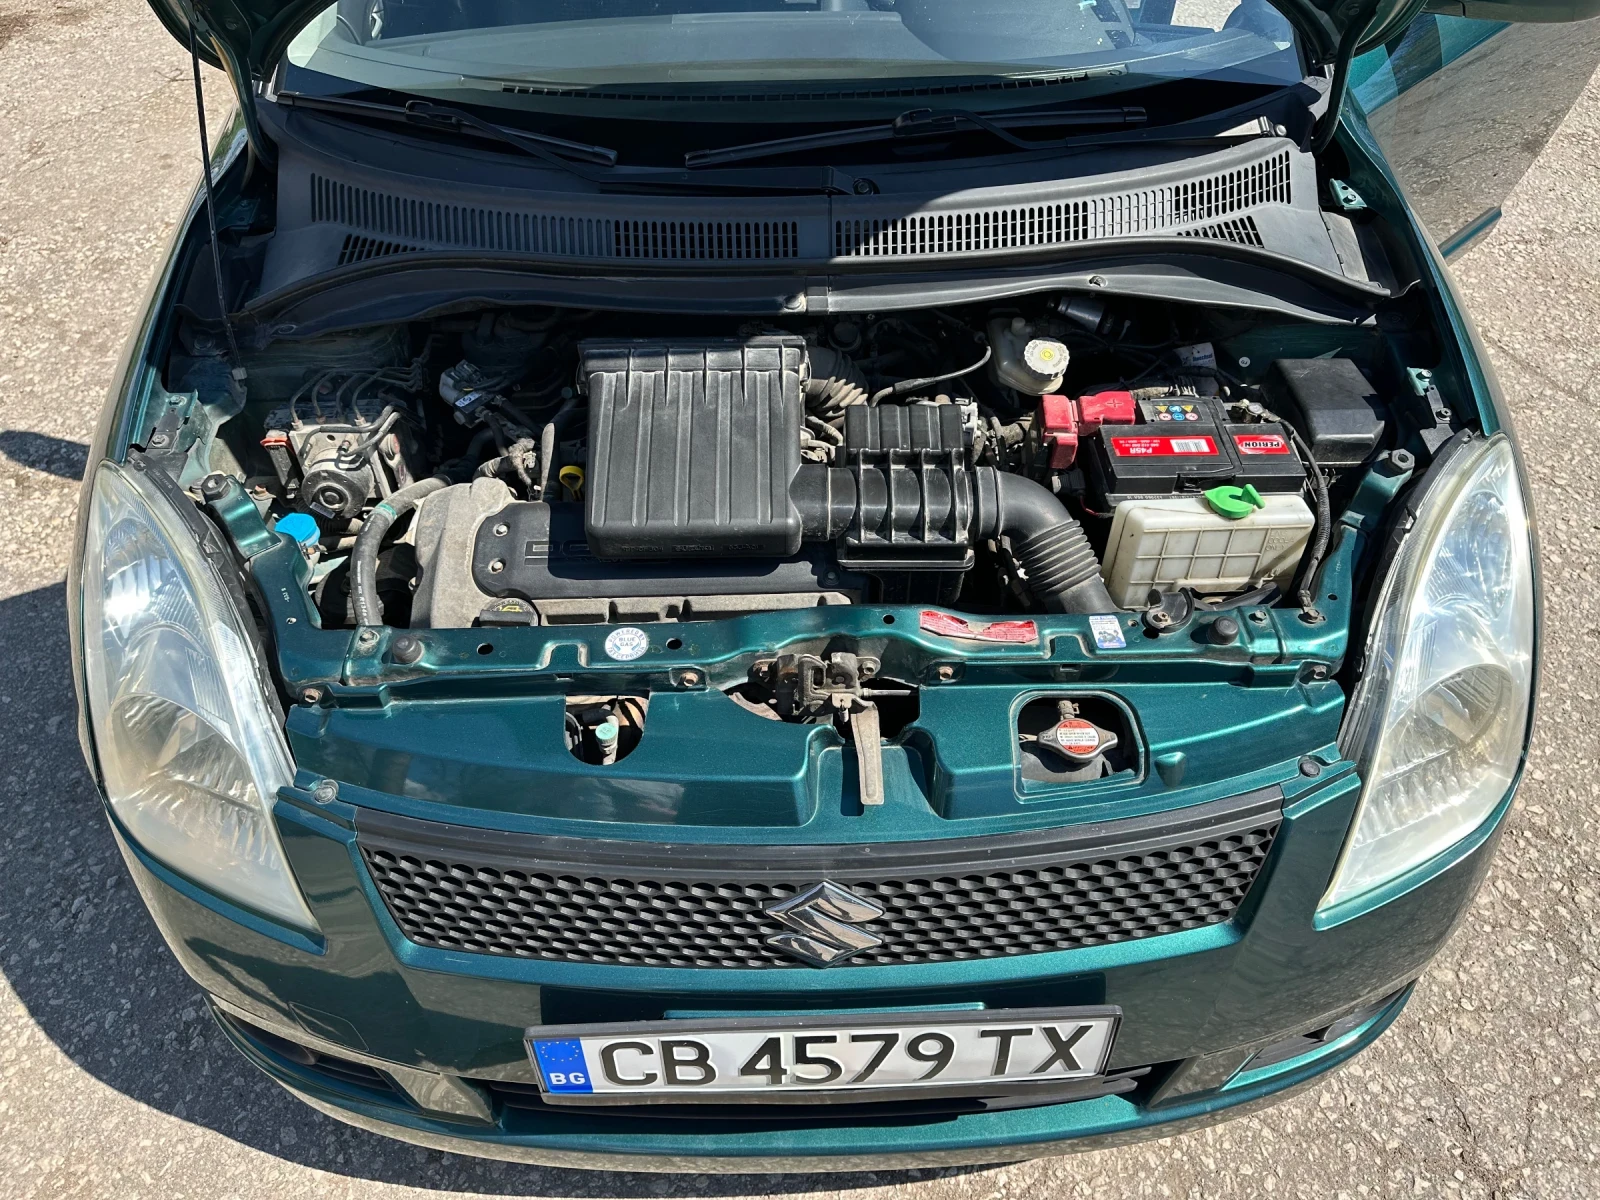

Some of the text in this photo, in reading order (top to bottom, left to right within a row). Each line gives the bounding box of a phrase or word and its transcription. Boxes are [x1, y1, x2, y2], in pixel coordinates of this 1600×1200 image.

[1129, 446, 1153, 454] P45R
[600, 1024, 1094, 1087] CB 4579 TX
[550, 1072, 586, 1085] BG
